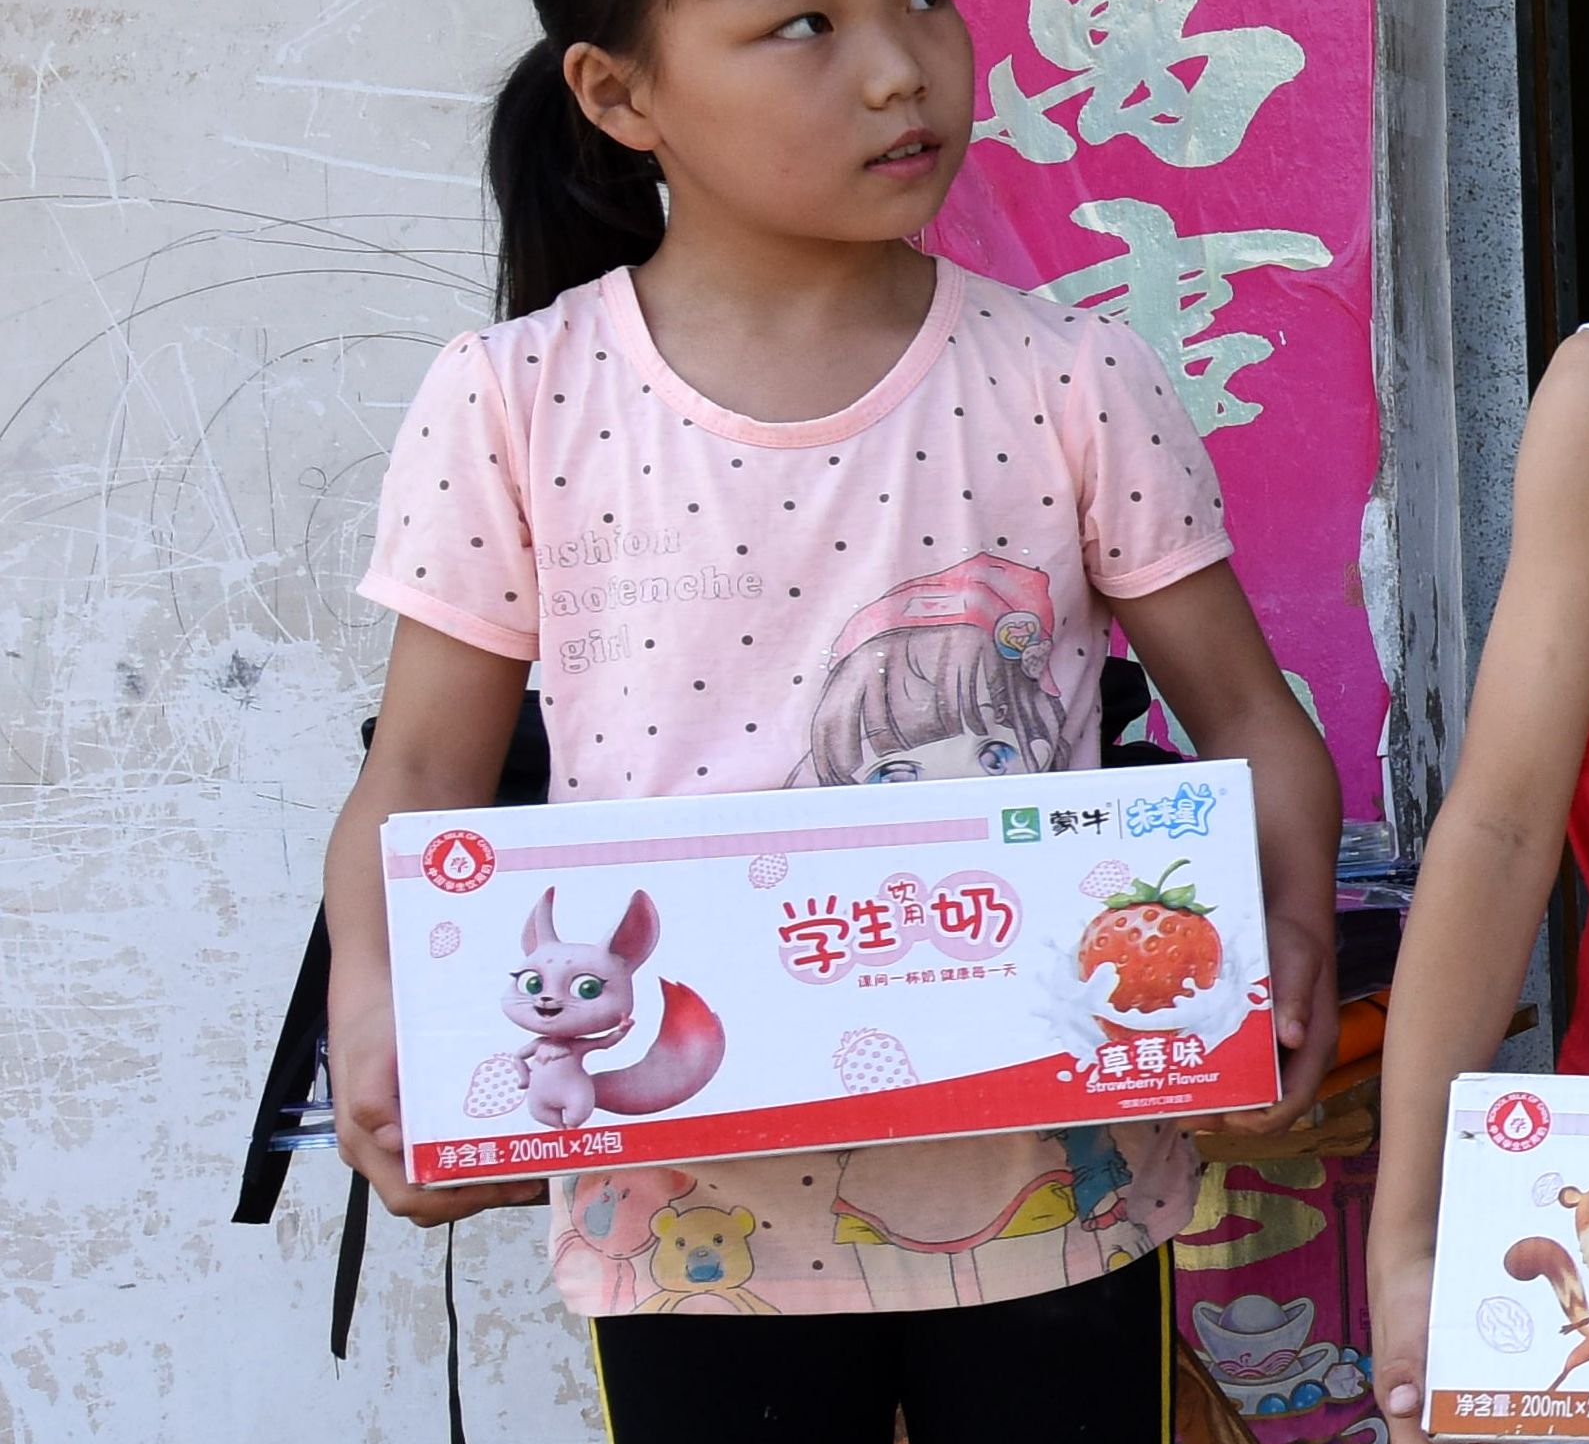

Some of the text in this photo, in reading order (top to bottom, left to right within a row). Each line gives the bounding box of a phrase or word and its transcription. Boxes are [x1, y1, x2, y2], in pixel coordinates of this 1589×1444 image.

[1049, 808, 1108, 837] 蒙牛
[1127, 783, 1216, 839] 未来星
[1100, 1036, 1204, 1078] 草莓味
[1085, 1071, 1220, 1094] Strawberry Flavour
